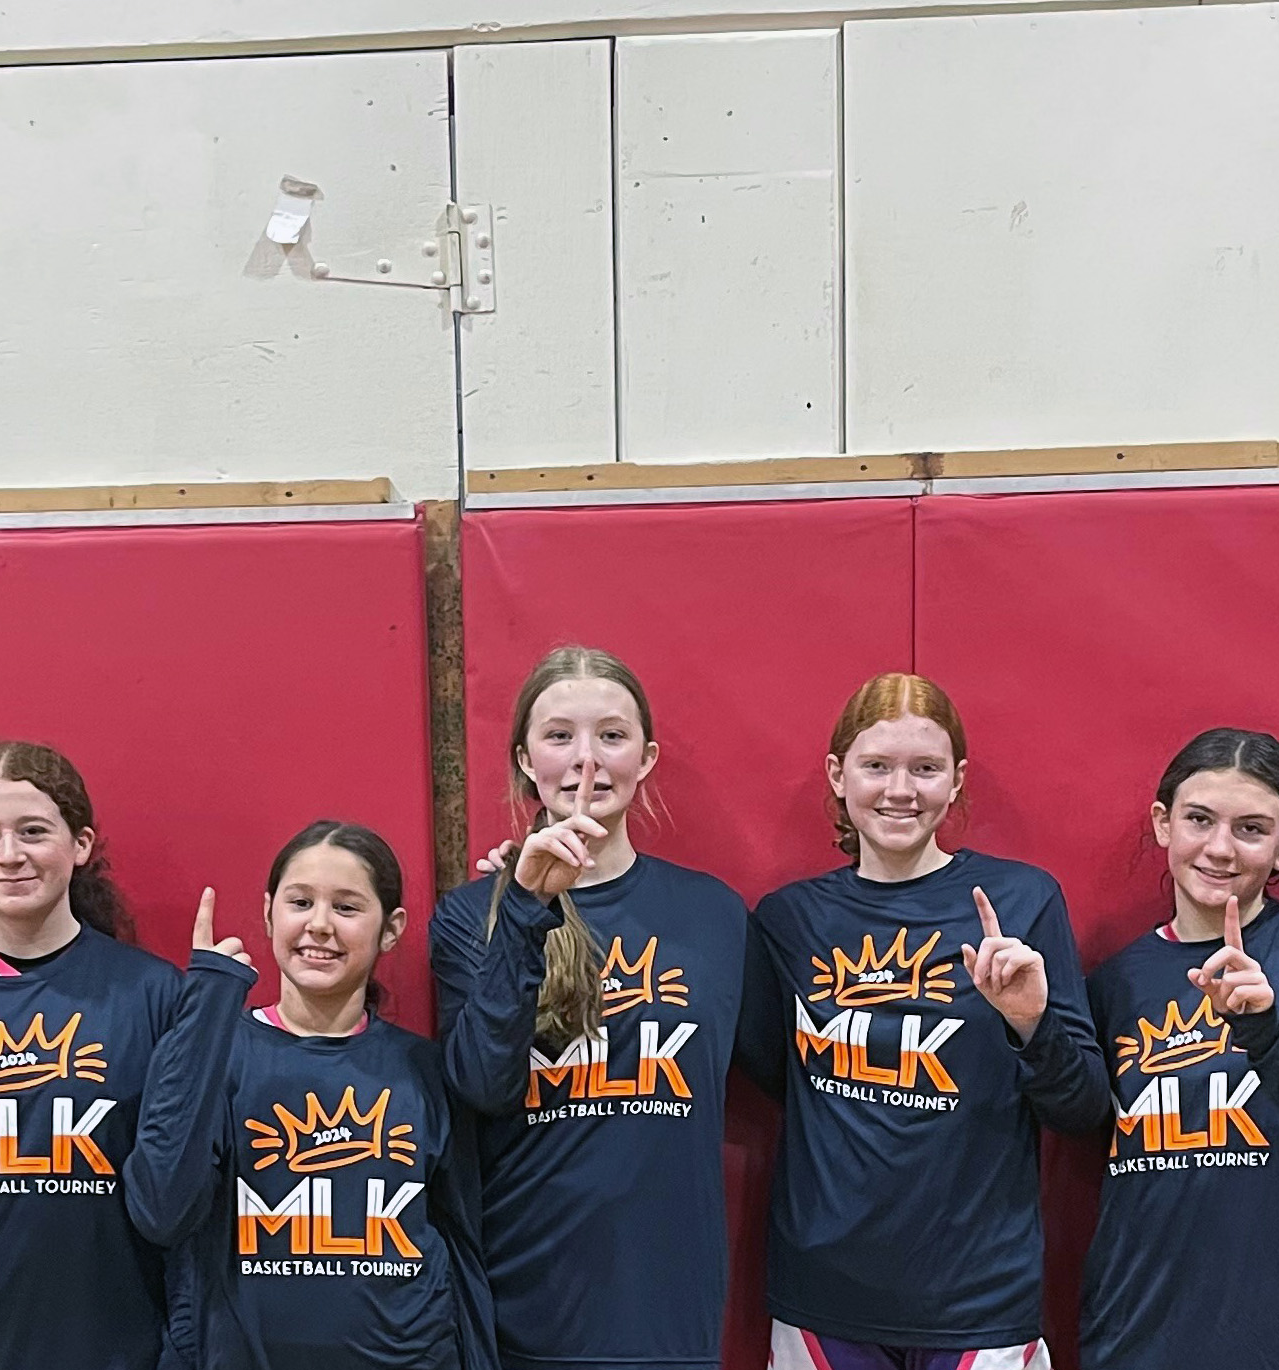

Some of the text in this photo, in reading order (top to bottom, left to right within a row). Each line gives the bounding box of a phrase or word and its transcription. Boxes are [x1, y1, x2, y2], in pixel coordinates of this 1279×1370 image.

[602, 976, 622, 992] 24
[858, 969, 895, 983] 2024
[795, 993, 965, 1094] MLK
[1165, 1029, 1204, 1048] 2024
[525, 1020, 699, 1108] MLK
[620, 1100, 692, 1118] TOURNEY
[881, 1089, 959, 1112] TOURNEY
[1109, 1069, 1271, 1157] MLK
[312, 1126, 352, 1145] 2024
[1193, 1152, 1270, 1168] TOURNEY
[34, 1178, 117, 1195] TOURNEY
[237, 1176, 425, 1258] MLK
[241, 1260, 423, 1277] BASKETBALL TOURNEY
